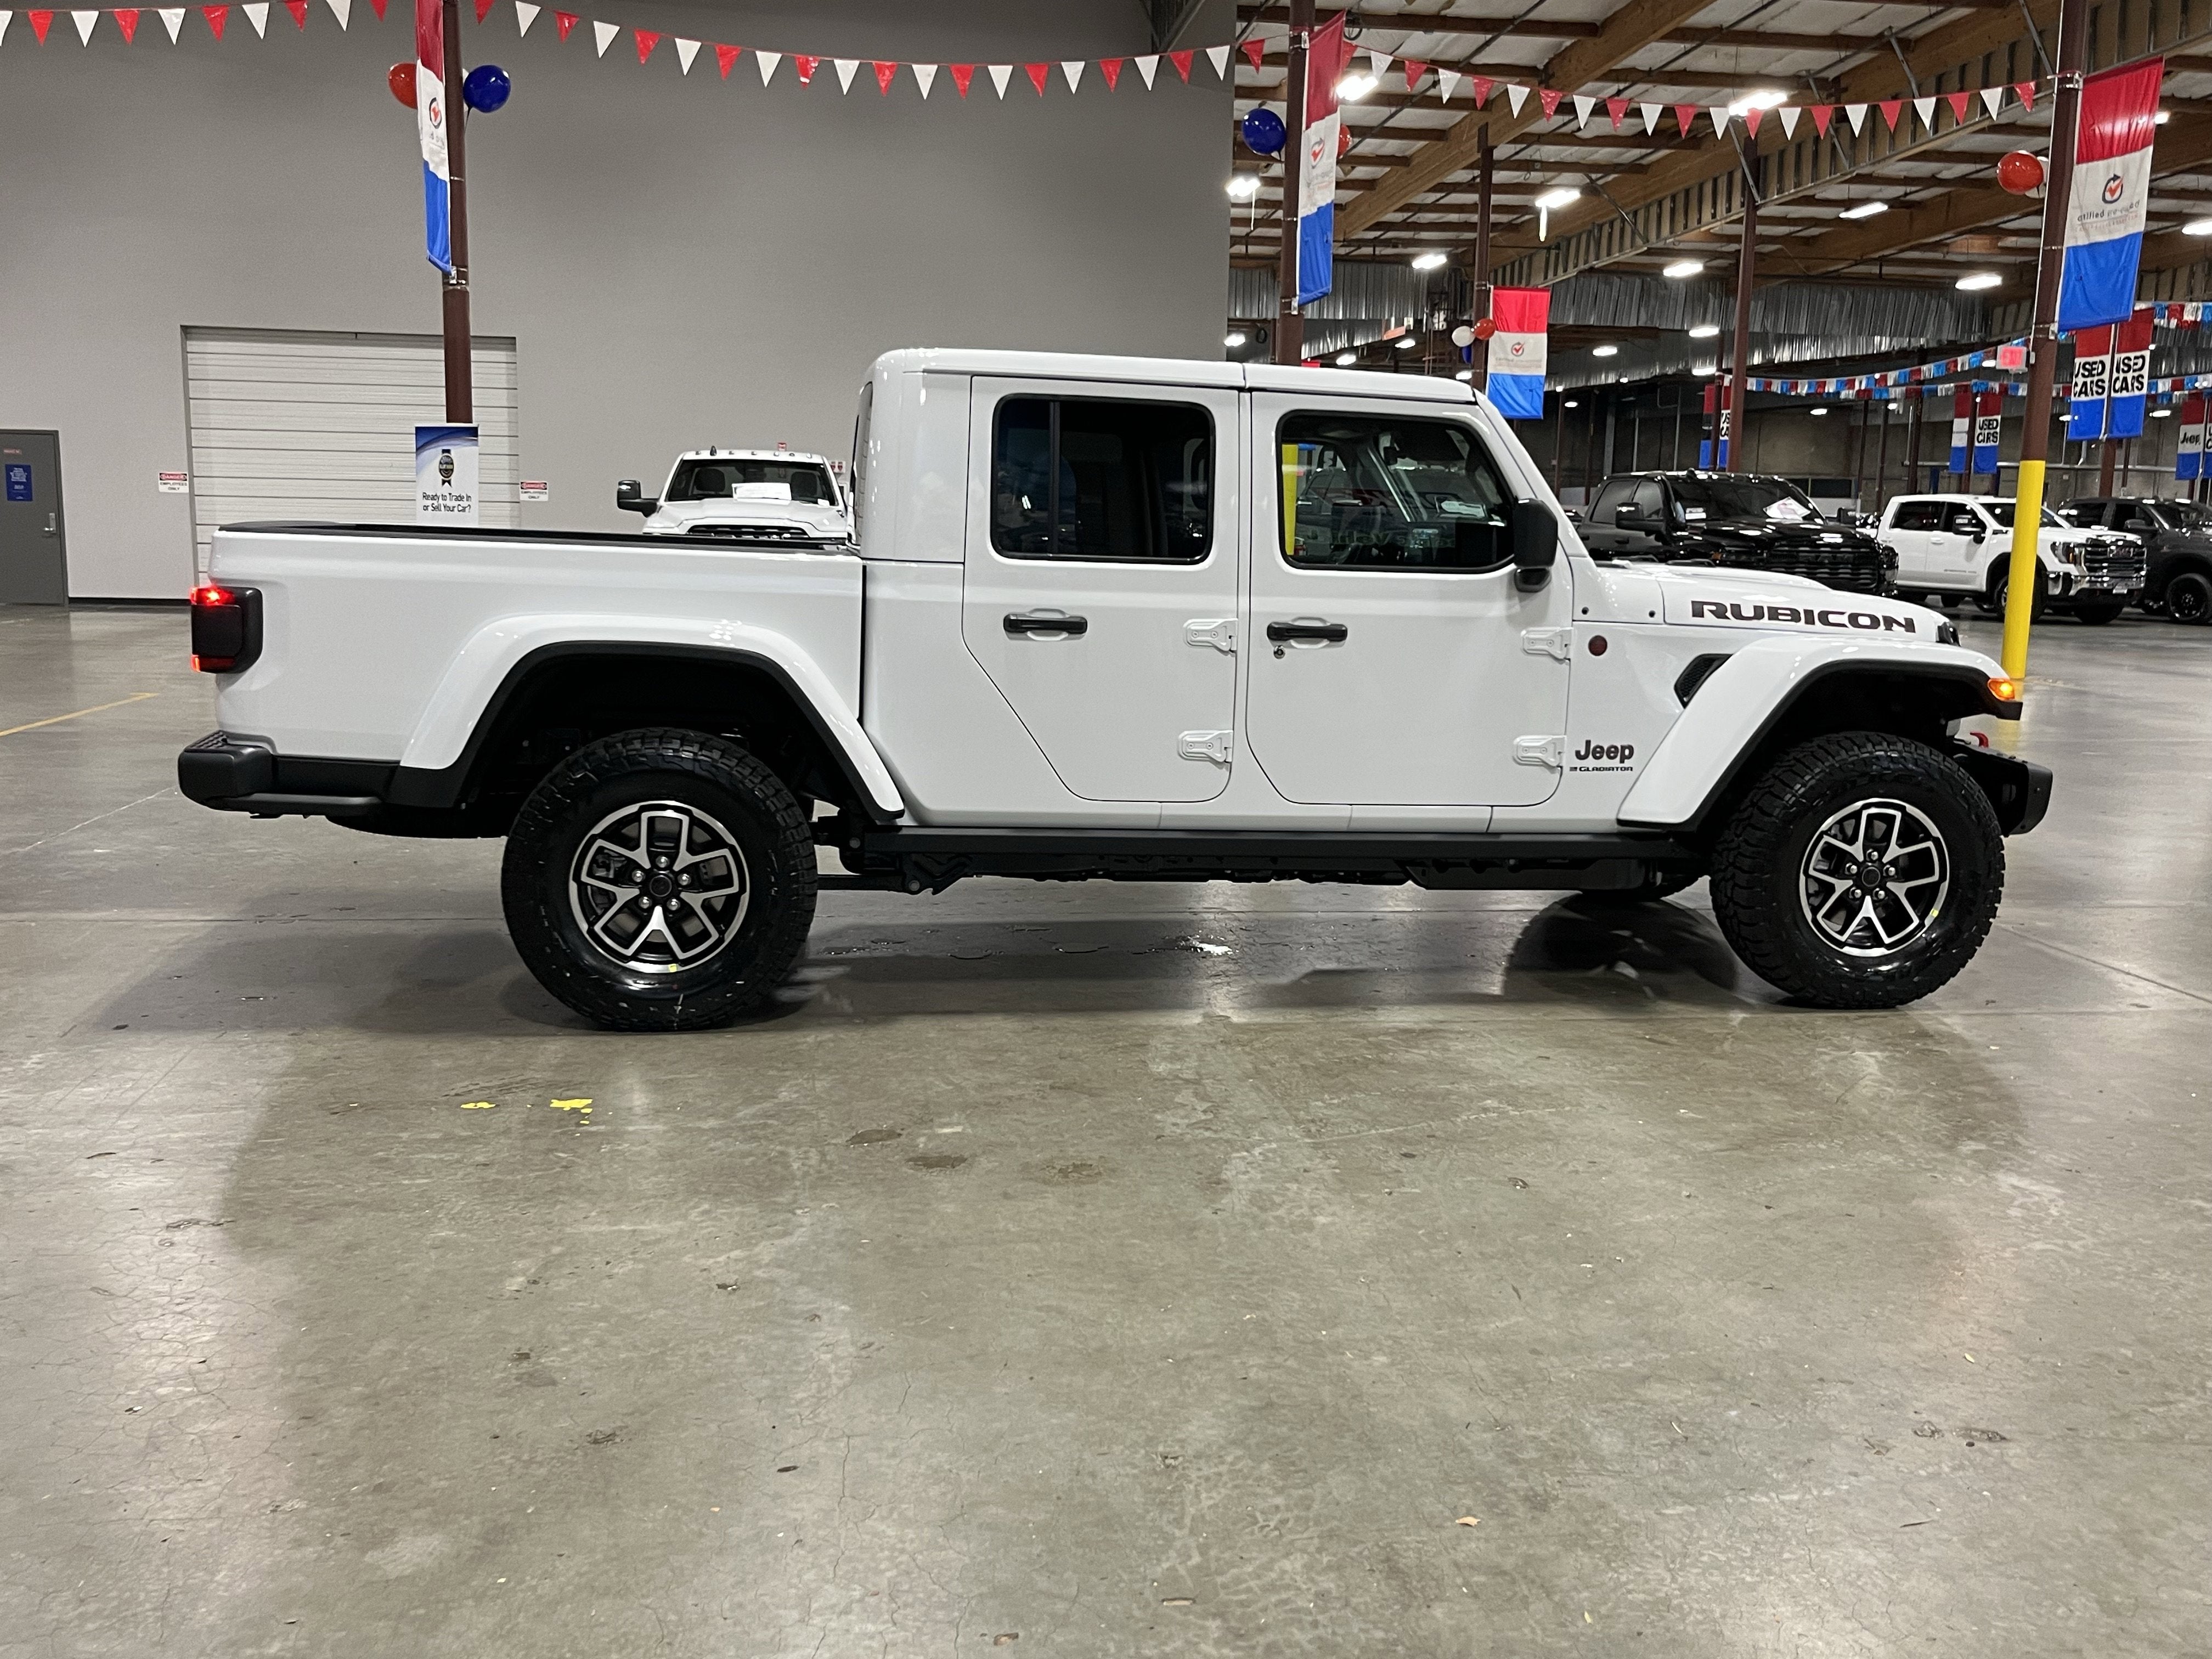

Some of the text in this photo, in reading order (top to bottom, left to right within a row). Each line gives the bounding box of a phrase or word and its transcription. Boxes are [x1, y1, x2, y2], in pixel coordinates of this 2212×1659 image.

[1978, 419, 1999, 431] USED
[422, 492, 440, 503] Ready
[448, 493, 465, 501] Trade
[431, 503, 442, 512] Sell
[443, 503, 456, 512] Your
[457, 504, 471, 513] Car?
[1691, 600, 1916, 633] RUBICON
[1575, 739, 1634, 764] Jeep
